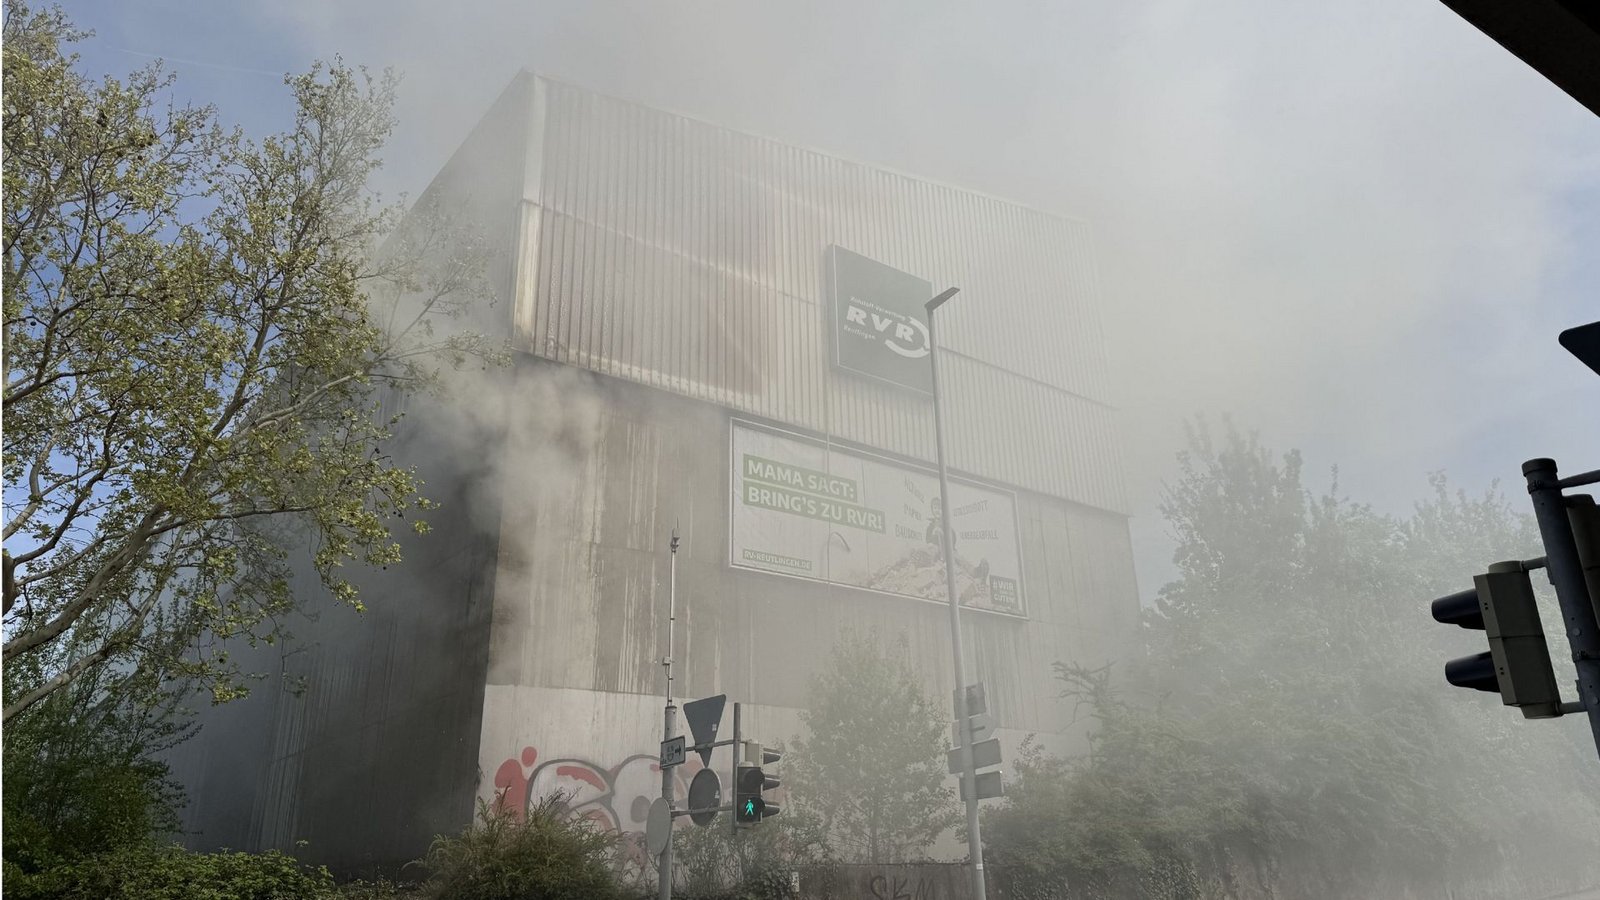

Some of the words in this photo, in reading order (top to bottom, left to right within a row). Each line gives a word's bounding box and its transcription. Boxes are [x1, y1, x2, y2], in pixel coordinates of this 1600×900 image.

[846, 305, 914, 342] RVR
[748, 460, 804, 488] MAMA
[807, 475, 854, 499] SAGT:
[748, 486, 817, 515] BRING'S
[821, 503, 842, 521] ZU
[847, 508, 882, 530] RVR!
